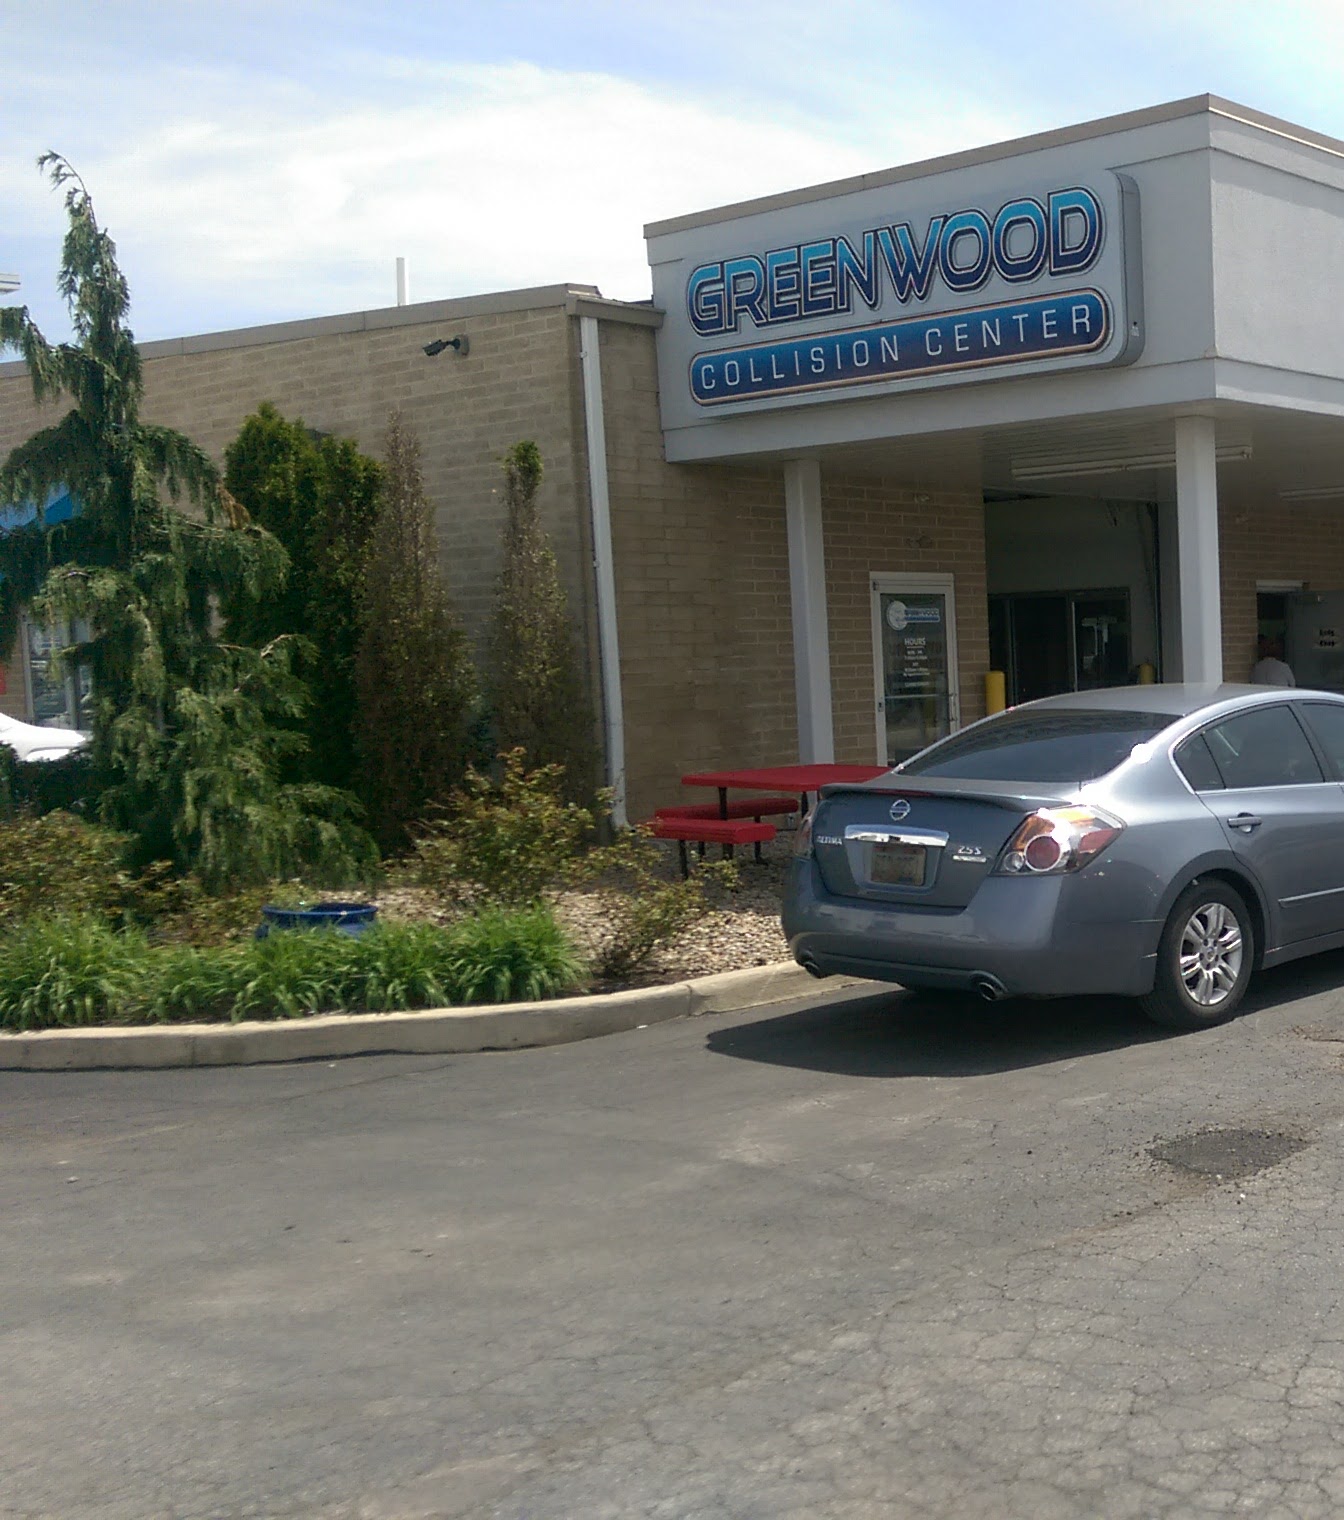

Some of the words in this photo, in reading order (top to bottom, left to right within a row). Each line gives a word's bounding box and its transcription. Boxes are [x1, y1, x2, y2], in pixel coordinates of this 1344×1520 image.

[688, 186, 1103, 337] GREENWOOD
[701, 335, 898, 390] COLLISION
[925, 303, 1091, 356] CENTER
[904, 637, 926, 646] HOURS
